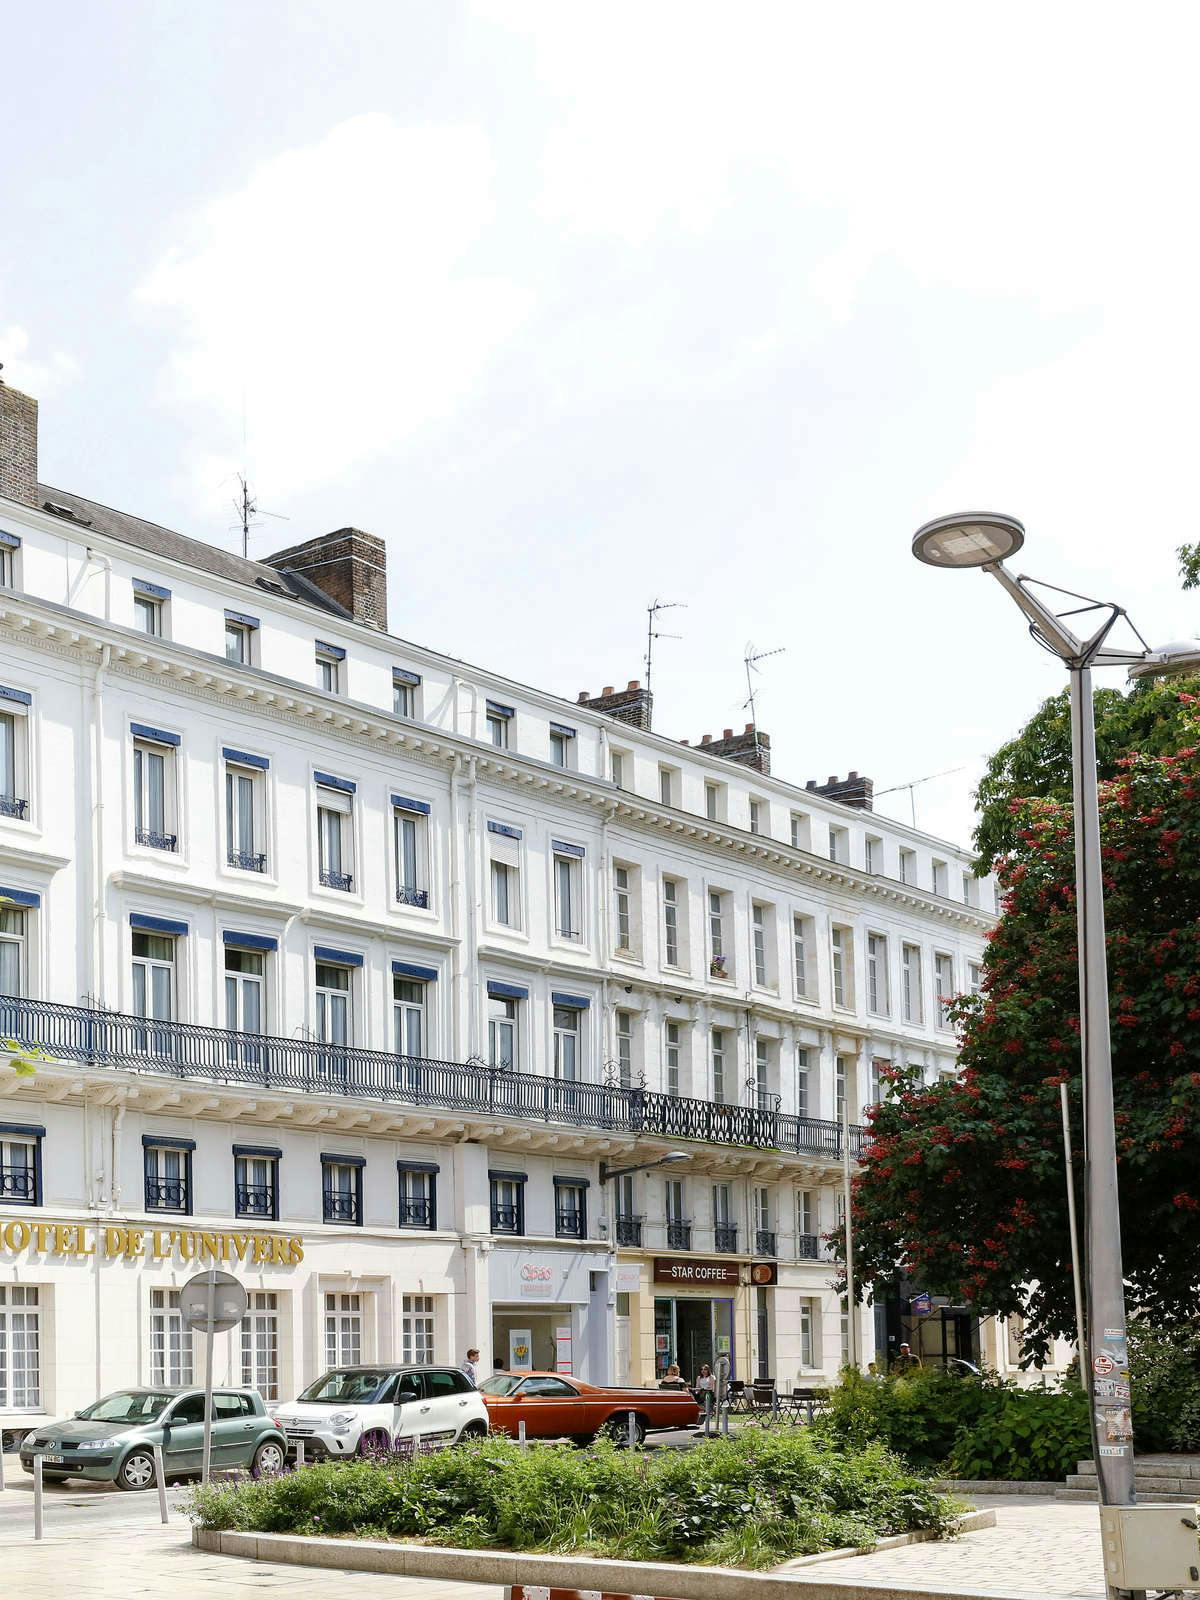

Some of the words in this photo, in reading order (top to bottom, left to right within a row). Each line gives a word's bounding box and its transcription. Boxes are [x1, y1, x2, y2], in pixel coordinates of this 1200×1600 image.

[104, 1227, 145, 1257] DE
[152, 1229, 305, 1265] L'UNIVERS
[671, 1266, 693, 1279] STAR
[695, 1267, 727, 1280] COFFEE
